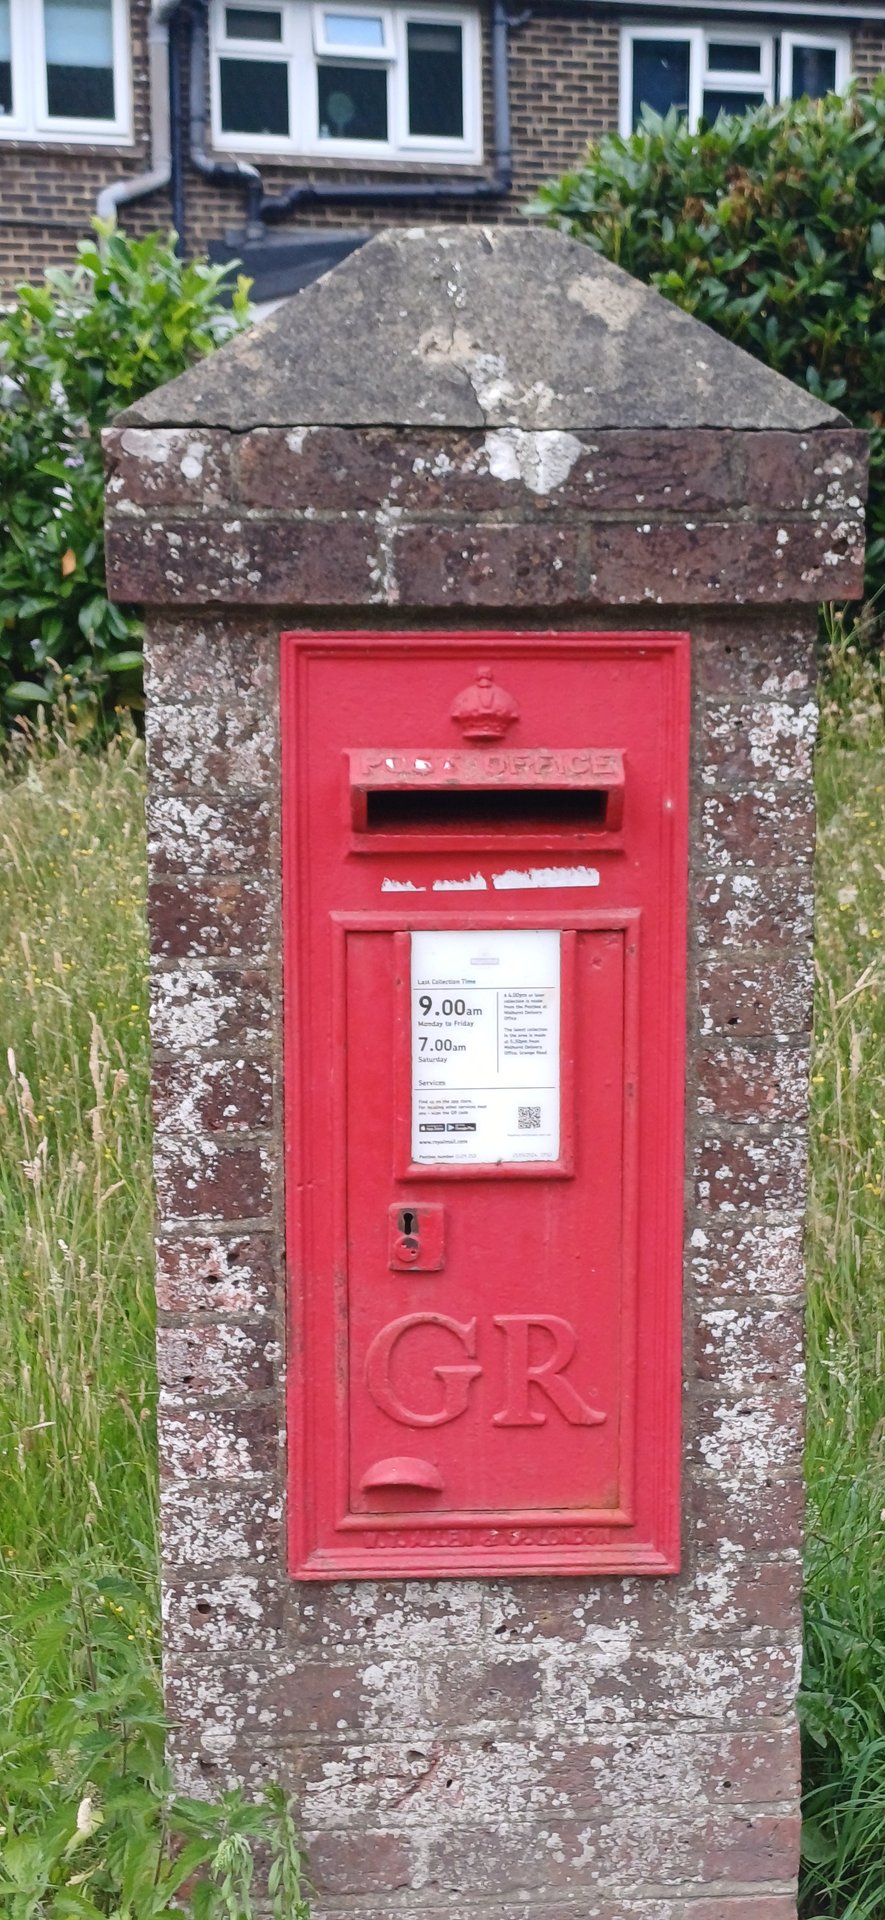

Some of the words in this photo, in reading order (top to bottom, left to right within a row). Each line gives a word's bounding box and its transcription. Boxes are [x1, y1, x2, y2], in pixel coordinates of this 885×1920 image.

[361, 755, 461, 776] POST
[485, 755, 615, 776] OFFICE
[418, 995, 482, 1016] 9.00am
[418, 1037, 466, 1052] 7.00am
[364, 1311, 607, 1428] GR
